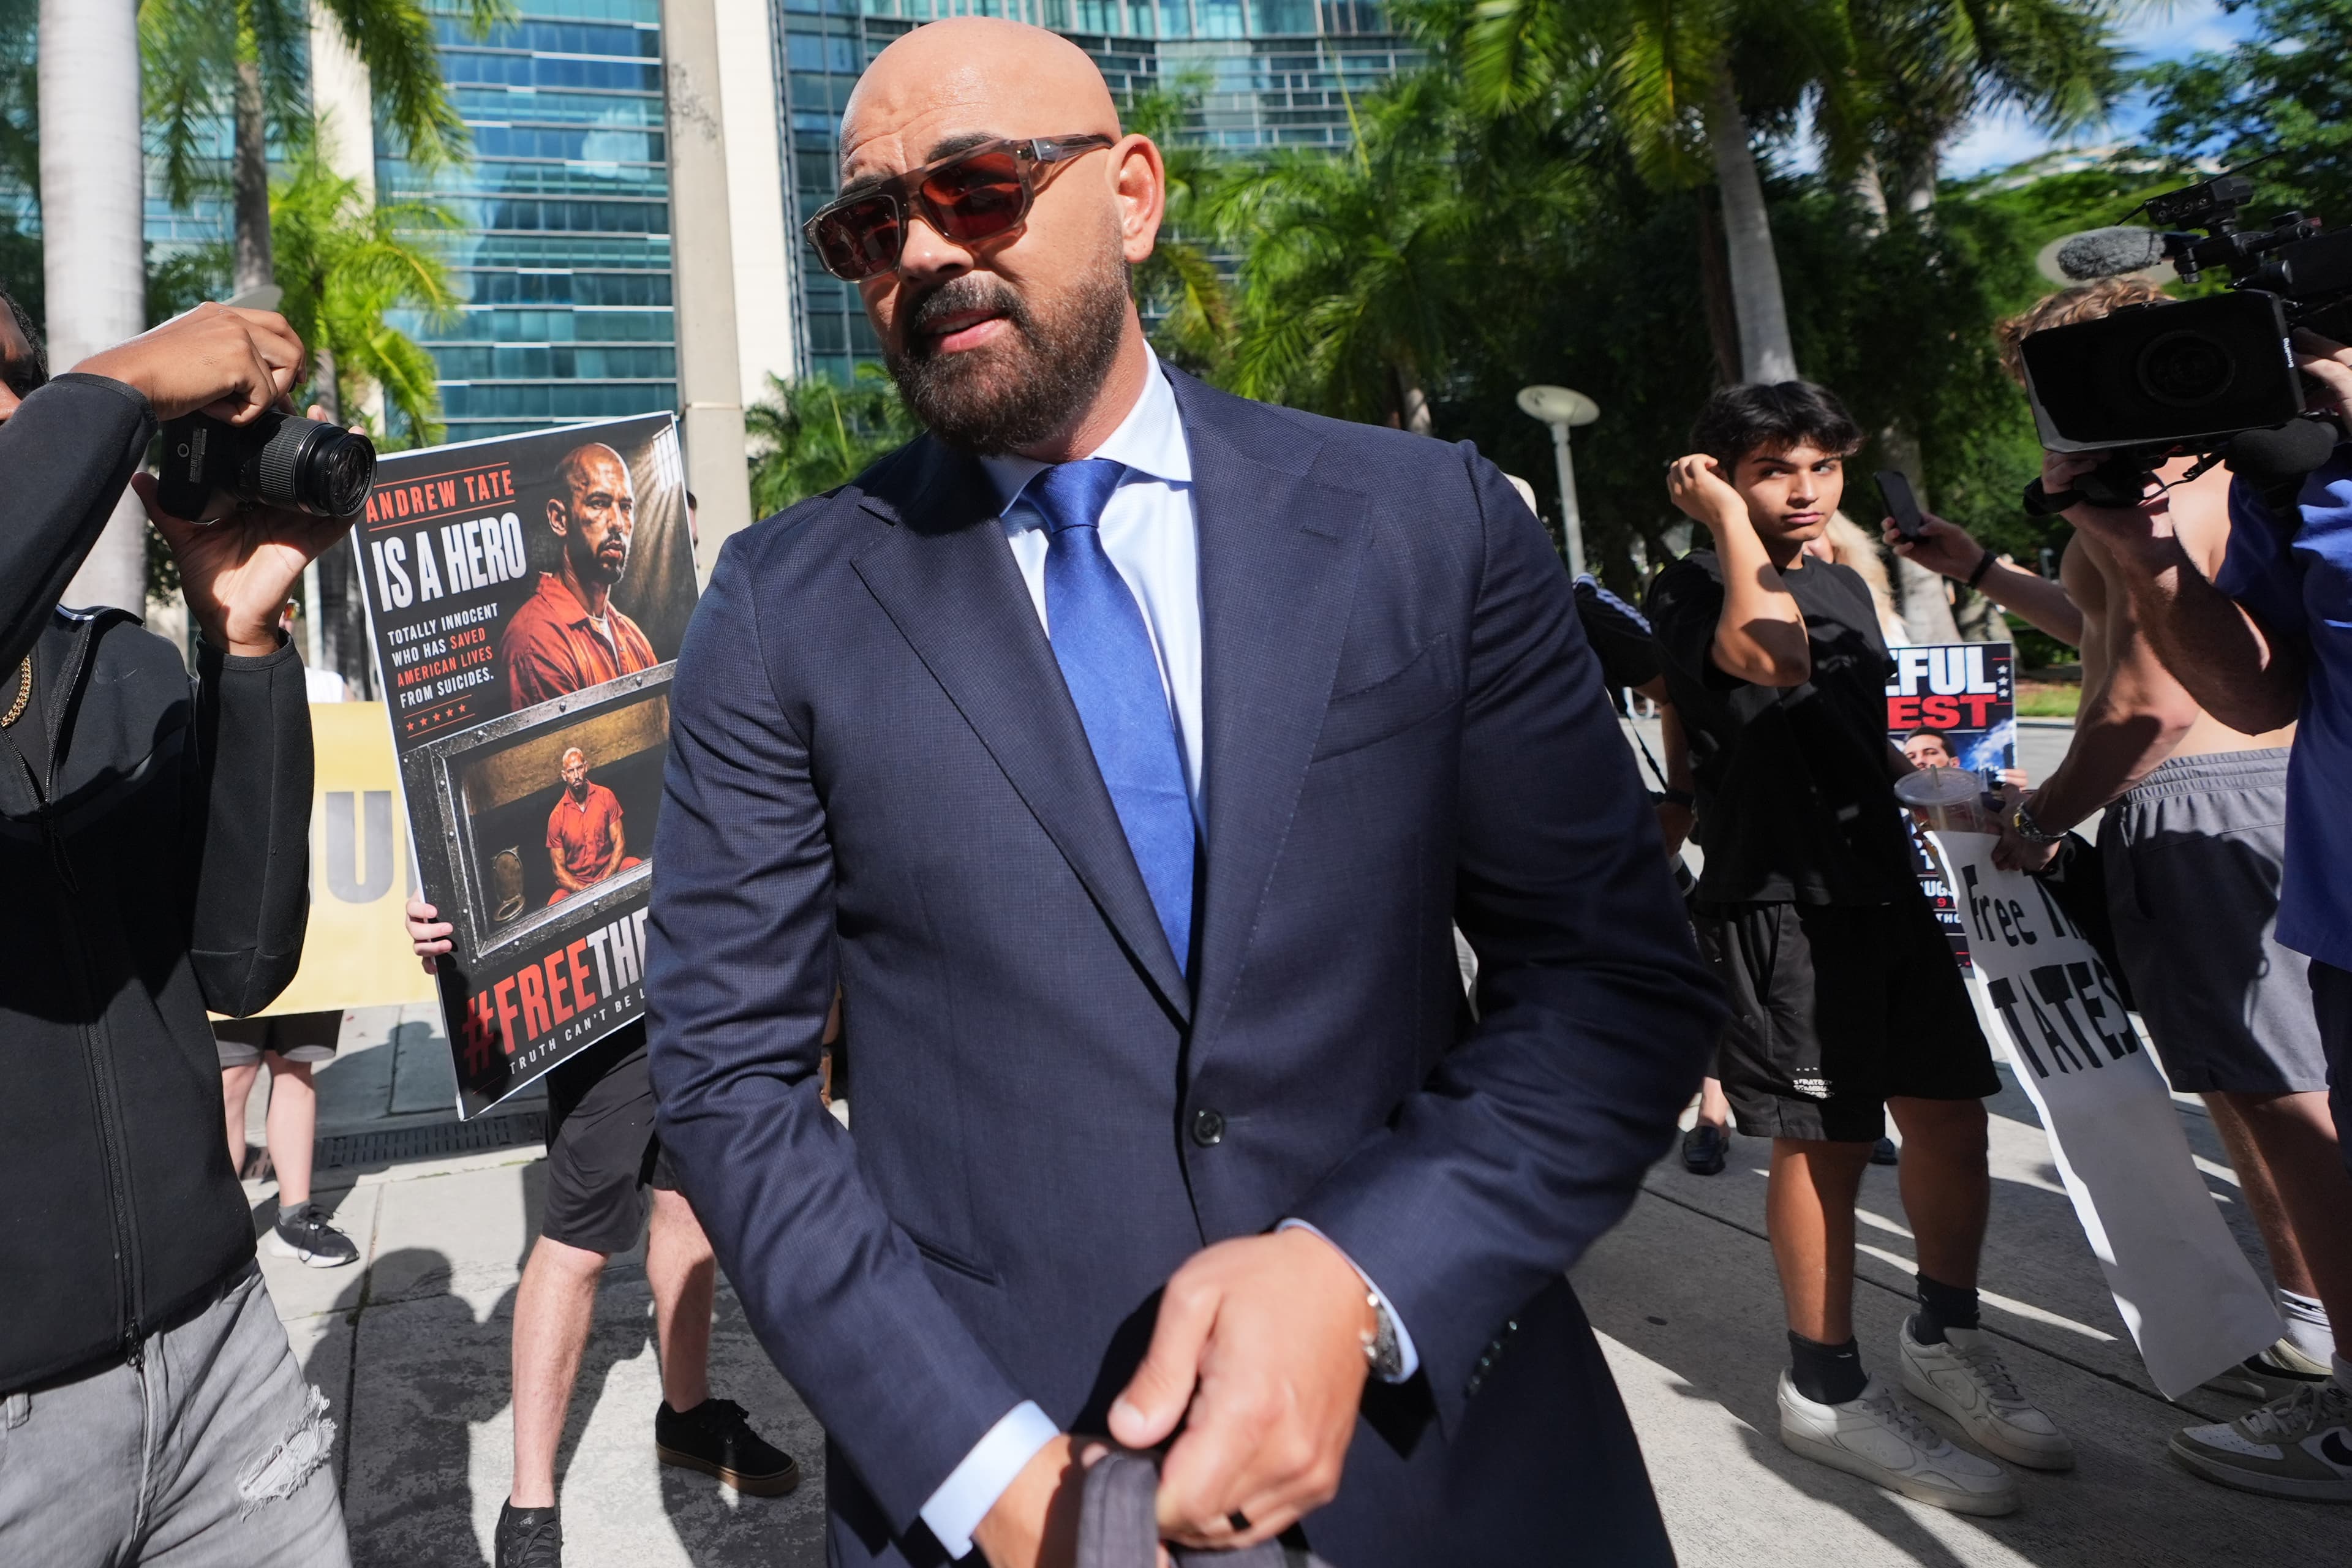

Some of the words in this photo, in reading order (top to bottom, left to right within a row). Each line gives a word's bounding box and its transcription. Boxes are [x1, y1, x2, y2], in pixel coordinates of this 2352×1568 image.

[366, 480, 456, 524] ANDREW
[464, 469, 514, 502] TATE
[371, 537, 413, 612] IS
[415, 531, 443, 602] A
[440, 512, 527, 595] HERO
[387, 619, 437, 646] TOTALLY
[440, 602, 499, 631] INNOCENT
[391, 646, 420, 667] WHO
[423, 638, 447, 658] HAS
[450, 627, 486, 650] SAVED
[398, 656, 457, 687] AMERICAN
[461, 646, 494, 668] LIVES
[399, 684, 434, 709] FROM
[436, 666, 494, 696] SUICIDES.
[1887, 694, 1998, 729] EST
[1961, 864, 2037, 947] Free
[509, 1038, 556, 1074] TRUTH
[564, 1008, 605, 1041] CAN'T
[614, 995, 631, 1012] BE
[1987, 957, 2139, 1079] TATES
